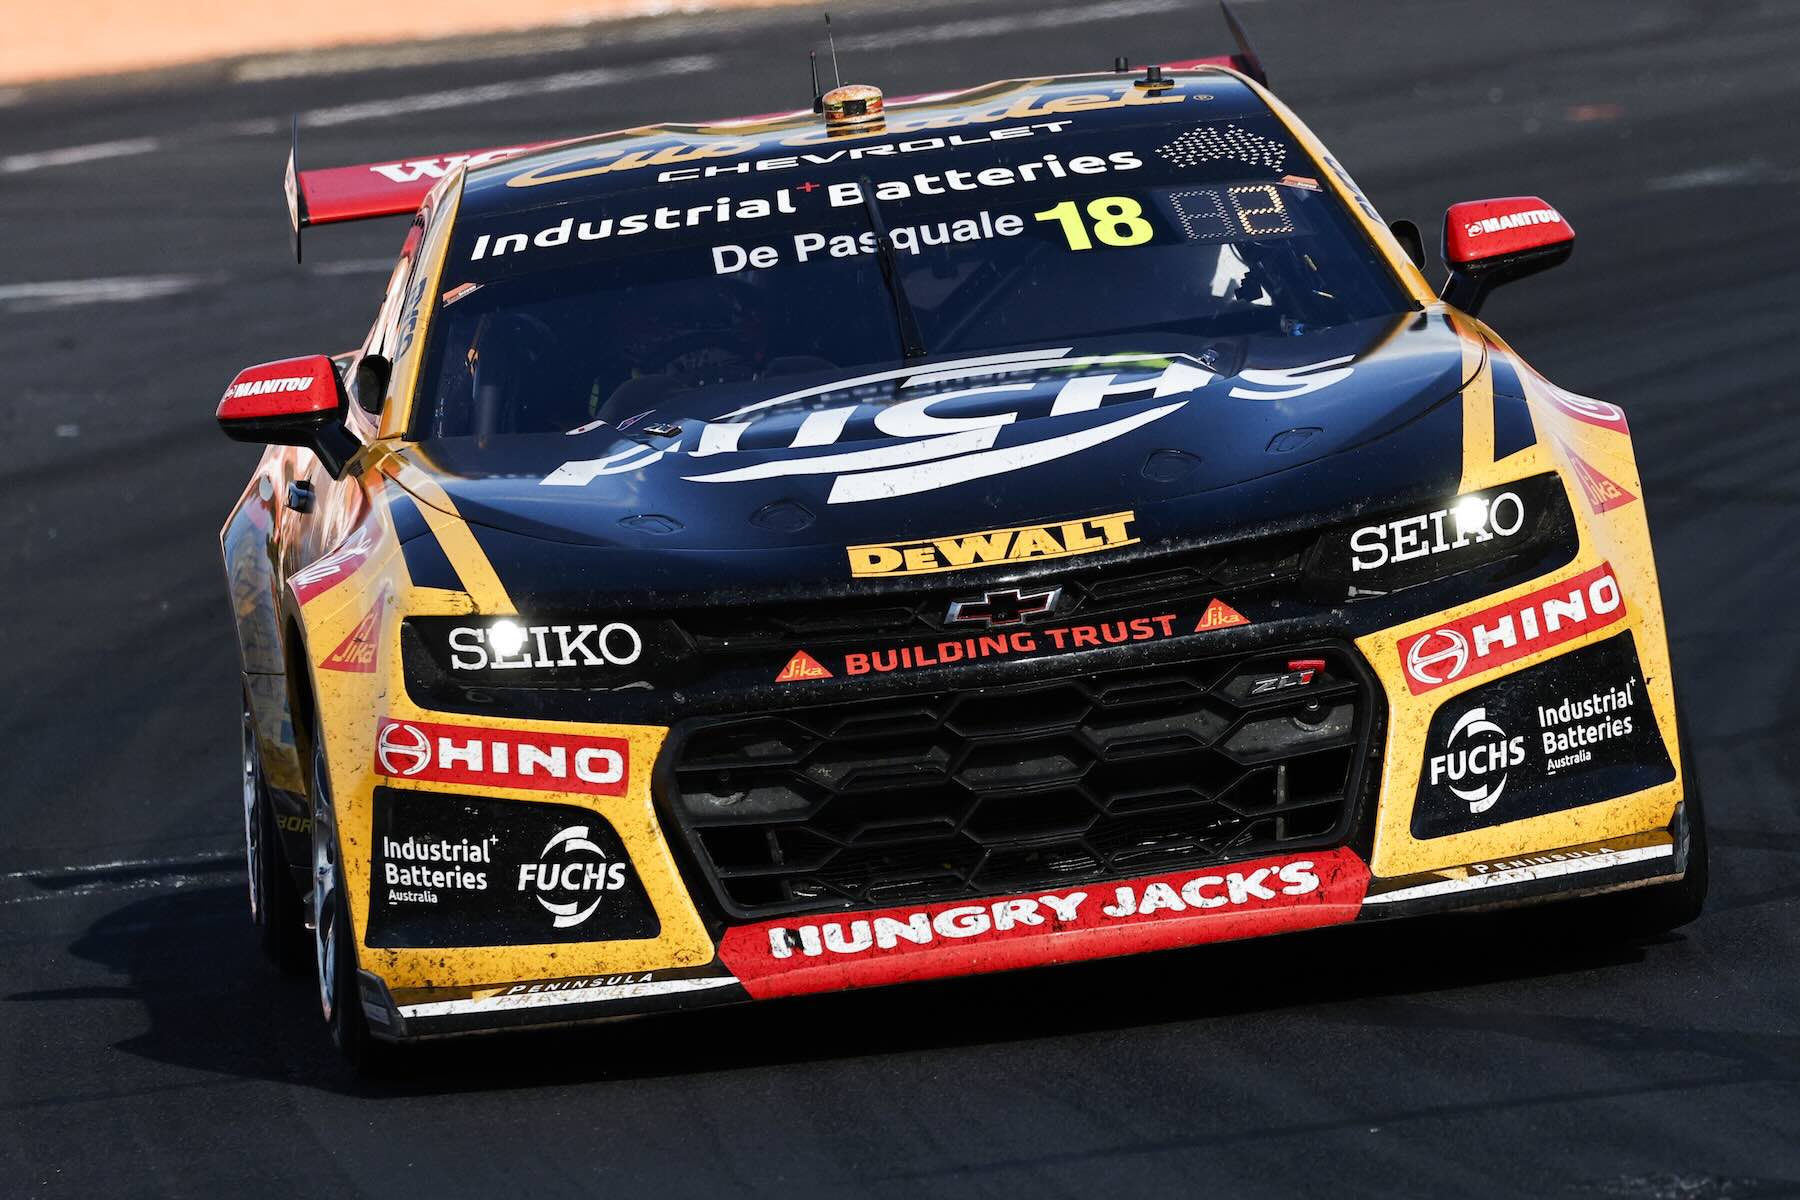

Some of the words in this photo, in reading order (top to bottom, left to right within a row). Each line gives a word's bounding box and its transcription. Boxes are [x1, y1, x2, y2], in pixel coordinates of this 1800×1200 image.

[658, 120, 1073, 183] CHEVROLET
[828, 150, 1144, 208] Batteries
[712, 243, 779, 275] De
[793, 208, 1024, 263] Pasquale
[1034, 196, 1154, 251] 18
[1480, 209, 1561, 233] MANITOU
[233, 376, 314, 399] MANITOU
[1350, 491, 1524, 572] SEIKO
[1199, 606, 1240, 628] Sika
[1472, 574, 1620, 657] HINO
[448, 622, 642, 671] SEIKO
[844, 633, 1036, 676] BUILDING
[1042, 613, 1177, 649] TRUST
[780, 658, 824, 678] Sika
[1542, 716, 1633, 754] Batteries
[438, 736, 624, 785] HINO
[1430, 735, 1526, 786] FUCHS
[1547, 749, 1592, 775] Australia
[384, 861, 488, 890] Batteries
[517, 861, 626, 892] FUCHS
[1471, 846, 1616, 875] PENINSULA
[388, 888, 438, 905] Australia
[768, 890, 1088, 959] HUNGRY
[1103, 860, 1320, 918] JACK'S
[506, 972, 653, 996] PENINSULA
